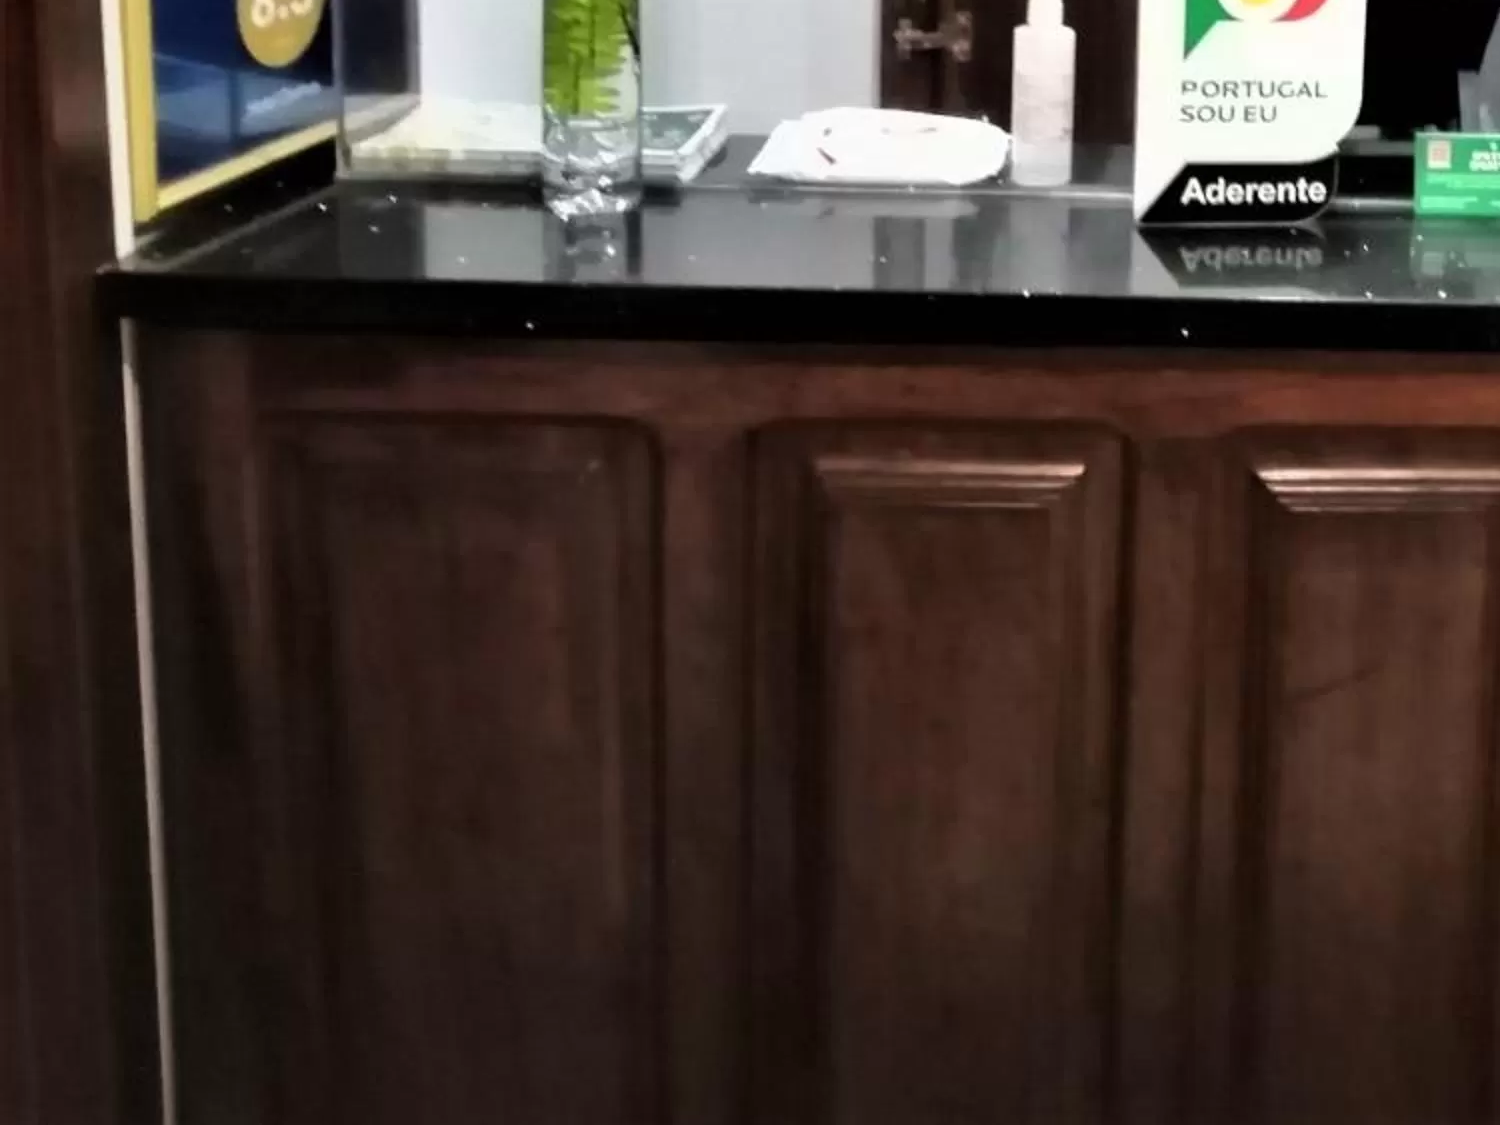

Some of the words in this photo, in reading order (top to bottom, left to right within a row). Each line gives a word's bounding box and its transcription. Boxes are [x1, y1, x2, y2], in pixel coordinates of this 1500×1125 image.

[1181, 80, 1328, 98] PORTUGAL
[1180, 105, 1236, 123] SOU
[1243, 105, 1278, 123] EU
[1181, 177, 1327, 205] Aderente
